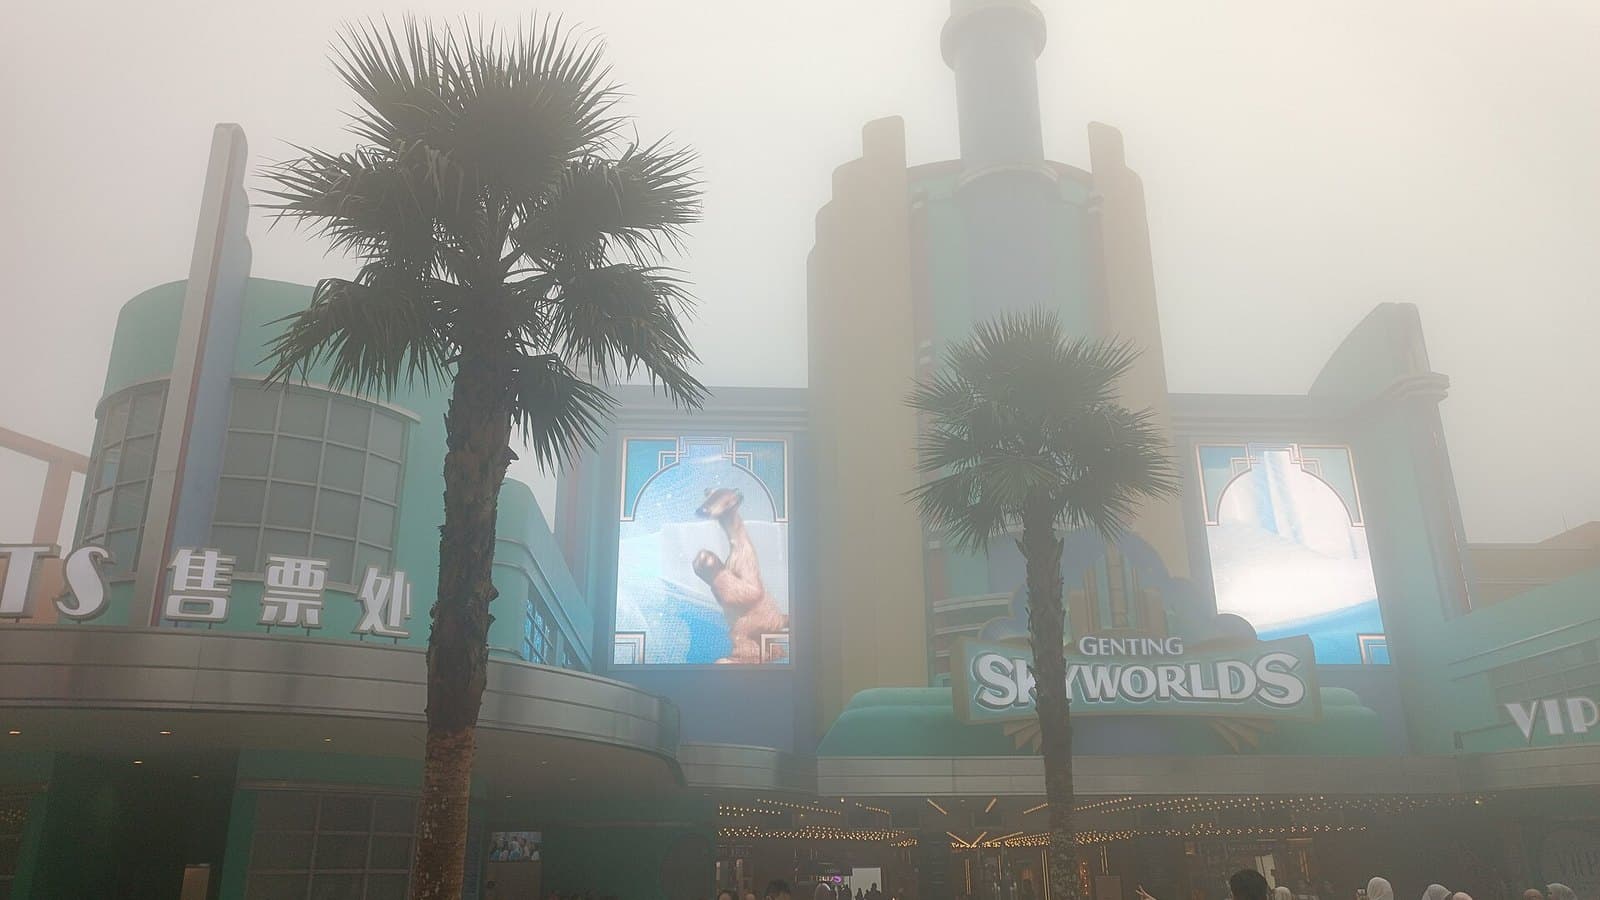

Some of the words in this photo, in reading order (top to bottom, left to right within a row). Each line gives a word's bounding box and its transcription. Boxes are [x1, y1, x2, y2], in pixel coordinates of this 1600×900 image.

[165, 548, 411, 636] 售票处
[1079, 635, 1184, 657] GENTING
[1505, 696, 1599, 741] VIP
